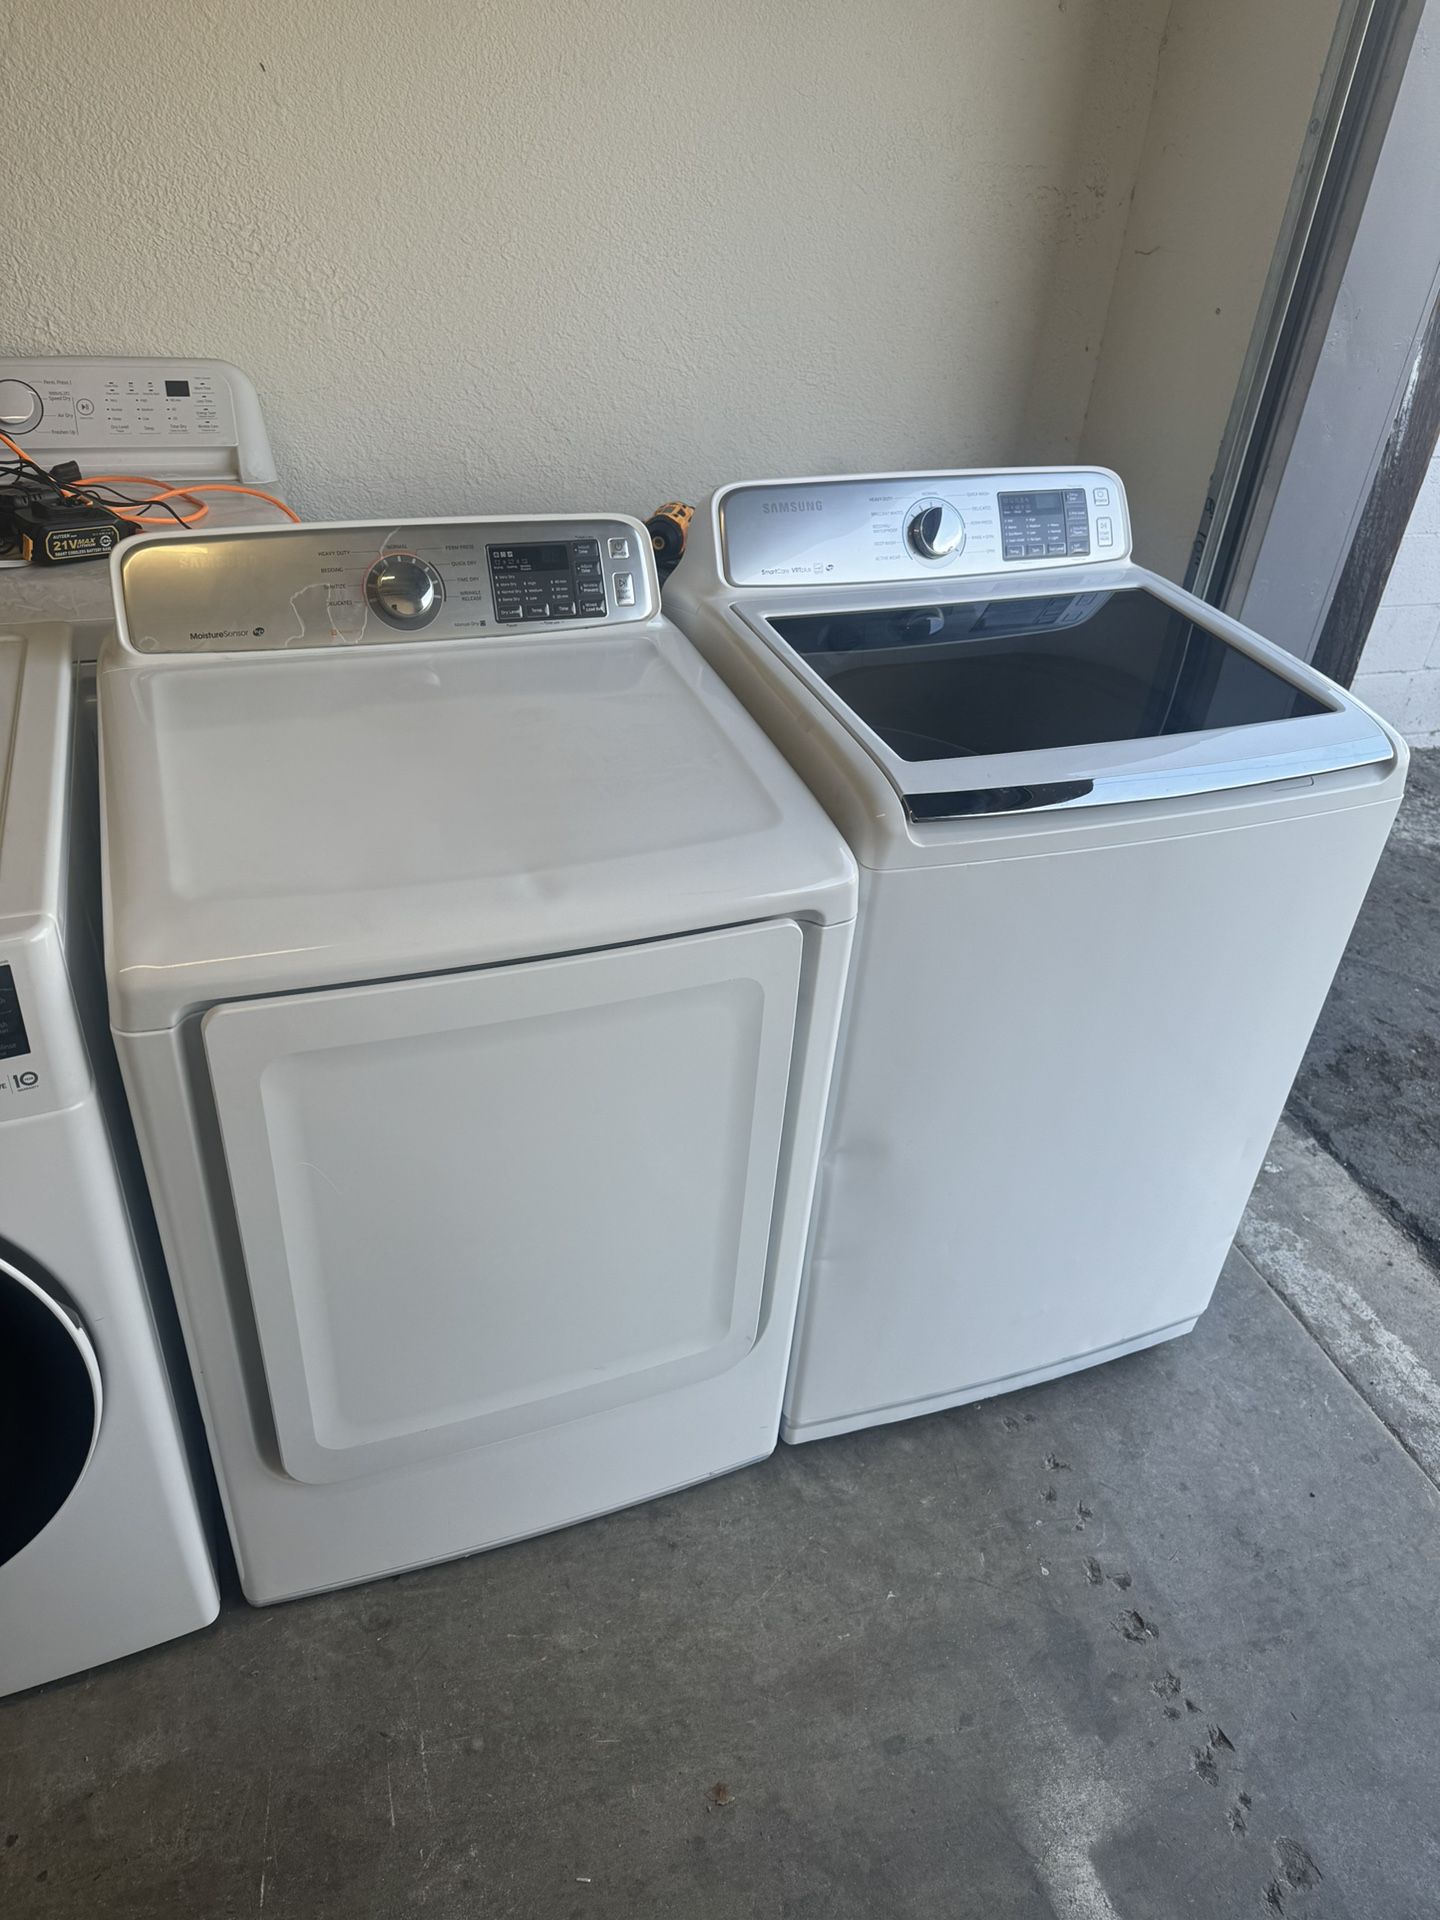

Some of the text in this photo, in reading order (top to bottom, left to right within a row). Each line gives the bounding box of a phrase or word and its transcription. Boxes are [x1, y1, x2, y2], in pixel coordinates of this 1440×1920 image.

[762, 500, 823, 514] SAMSUNG
[53, 539, 78, 551] 21V
[190, 630, 248, 641] MoistureSensor
